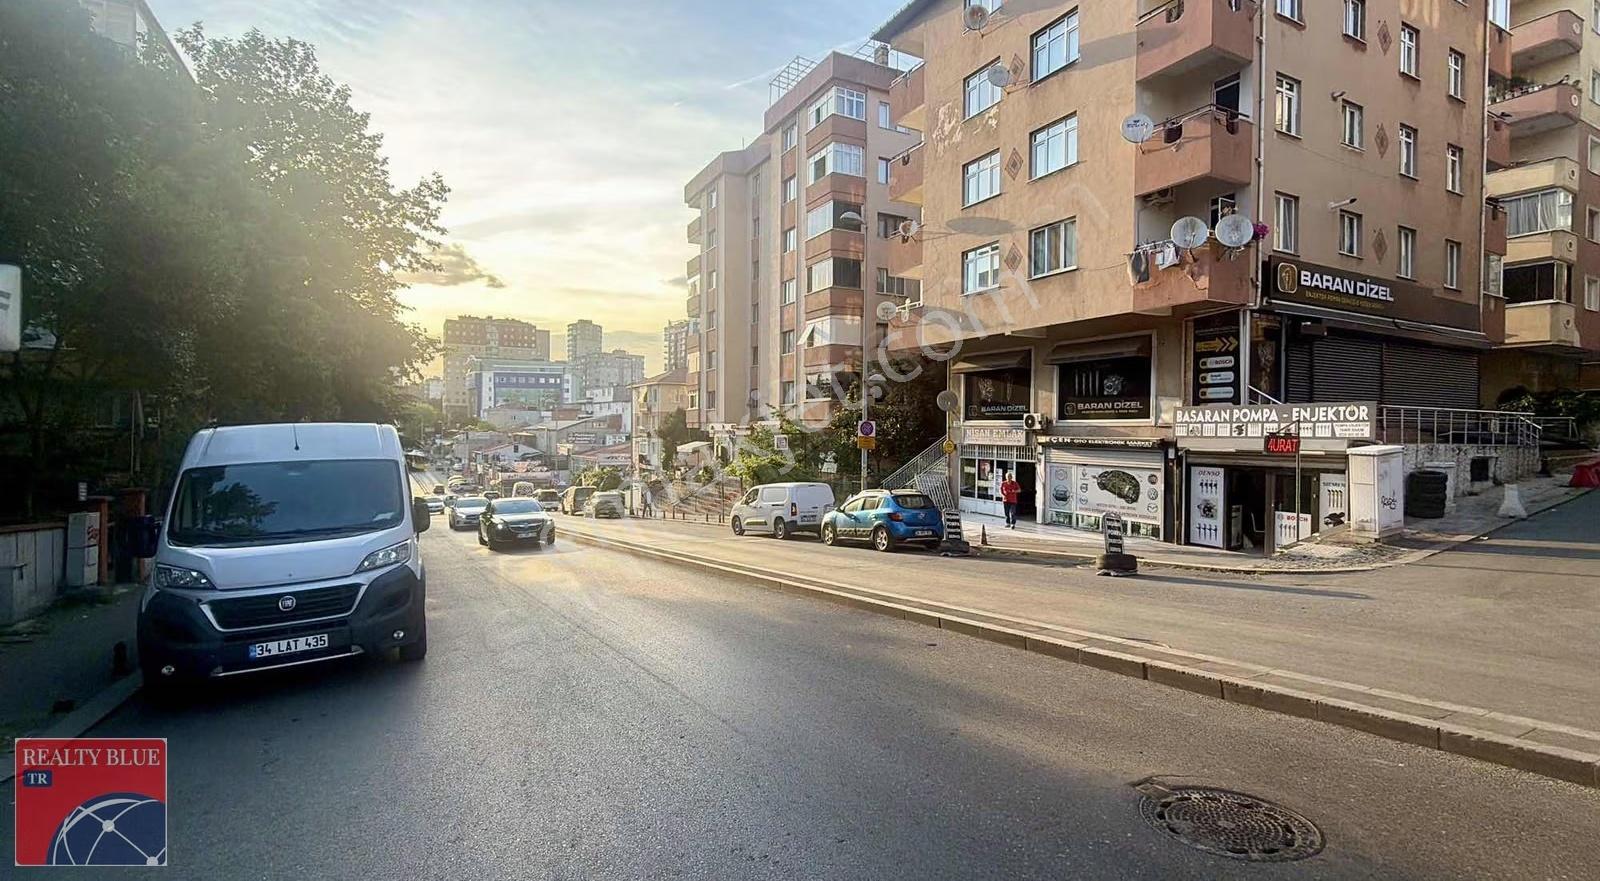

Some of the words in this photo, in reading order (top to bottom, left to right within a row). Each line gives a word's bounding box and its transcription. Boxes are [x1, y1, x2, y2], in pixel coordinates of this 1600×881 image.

[1300, 270, 1354, 294] BARAN
[1356, 278, 1394, 302] DİZEL
[1077, 402, 1112, 410] BARAN
[1113, 400, 1143, 409] DİZEL
[1232, 408, 1279, 422] POMPA
[993, 429, 1024, 438] EMLAK
[1286, 515, 1309, 523] BOCH
[256, 643, 272, 657] 34
[277, 639, 300, 654] LAT
[305, 635, 327, 649] 435
